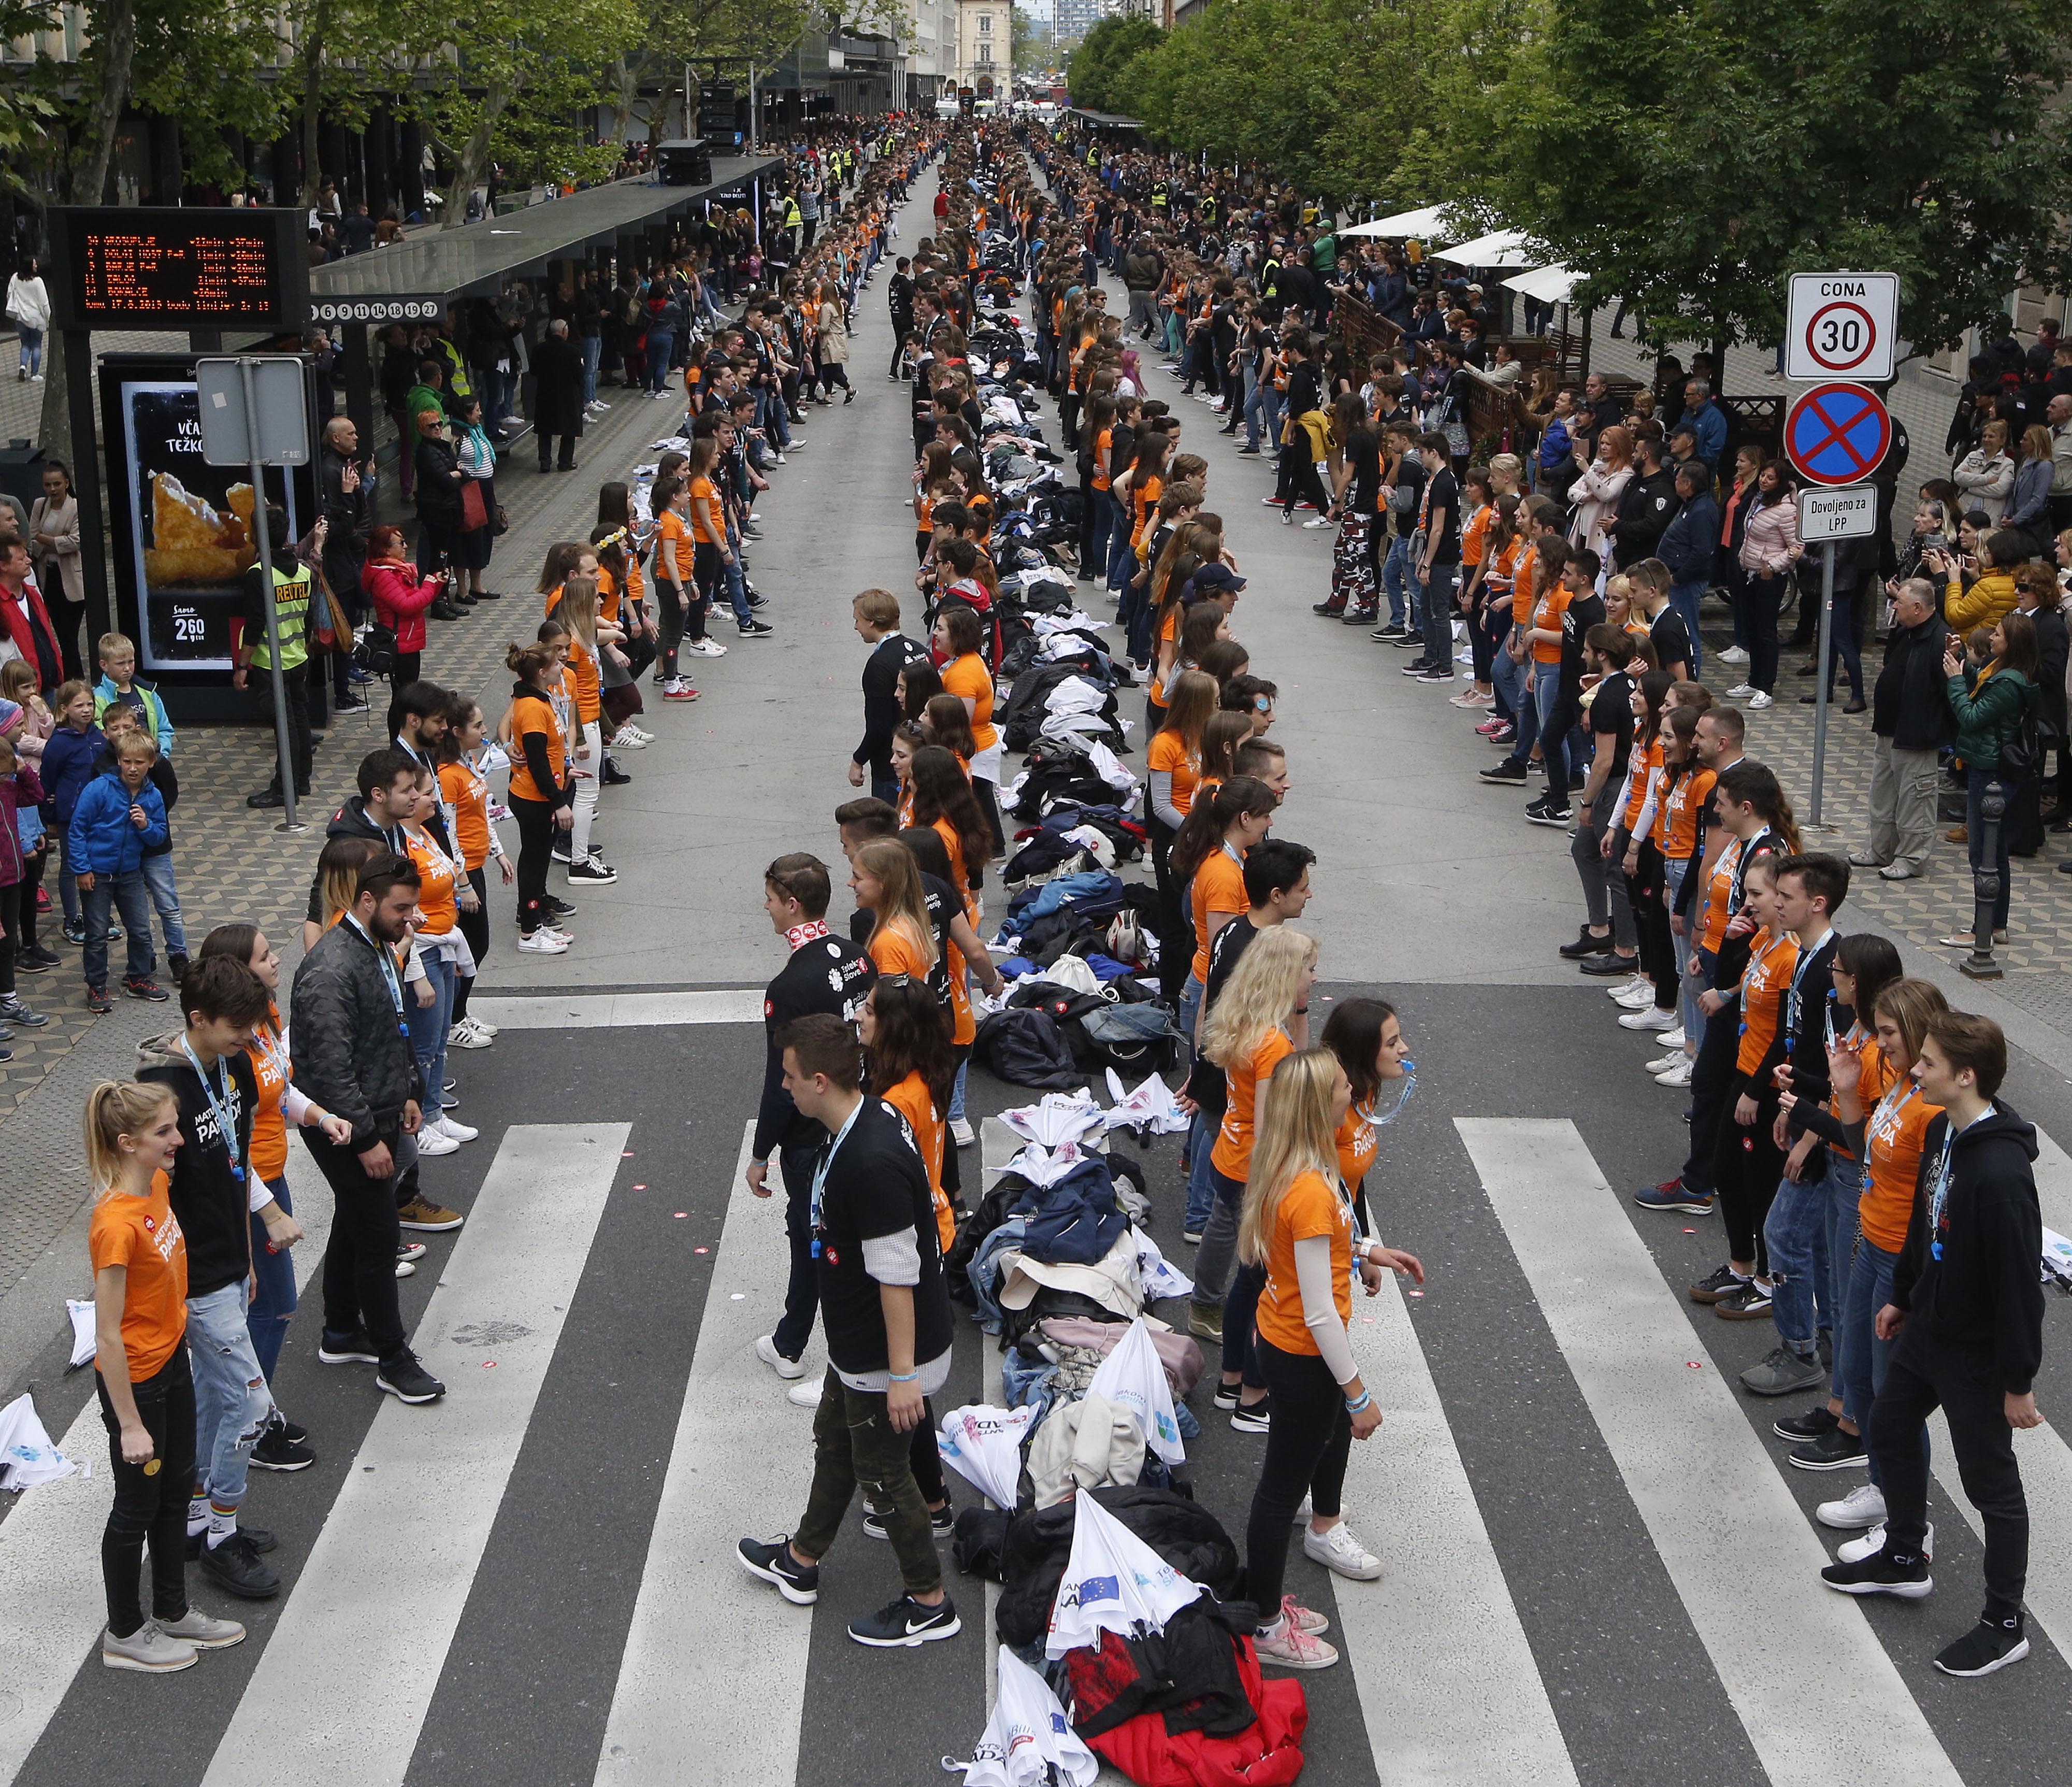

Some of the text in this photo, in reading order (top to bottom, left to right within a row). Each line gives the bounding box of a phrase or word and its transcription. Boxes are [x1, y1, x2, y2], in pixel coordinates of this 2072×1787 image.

[1821, 282, 1866, 297] CONA
[325, 306, 330, 317] 6
[342, 306, 348, 317] 9
[357, 306, 366, 317] 11
[374, 306, 384, 316] 14
[391, 306, 400, 315] 18
[407, 305, 418, 314] 19
[424, 305, 435, 313] 27
[1821, 320, 1860, 352] 30
[178, 419, 202, 435] VČA
[1811, 499, 1866, 514] Dovoljeno za
[1829, 517, 1847, 531] LPP
[173, 605, 195, 614] Samo
